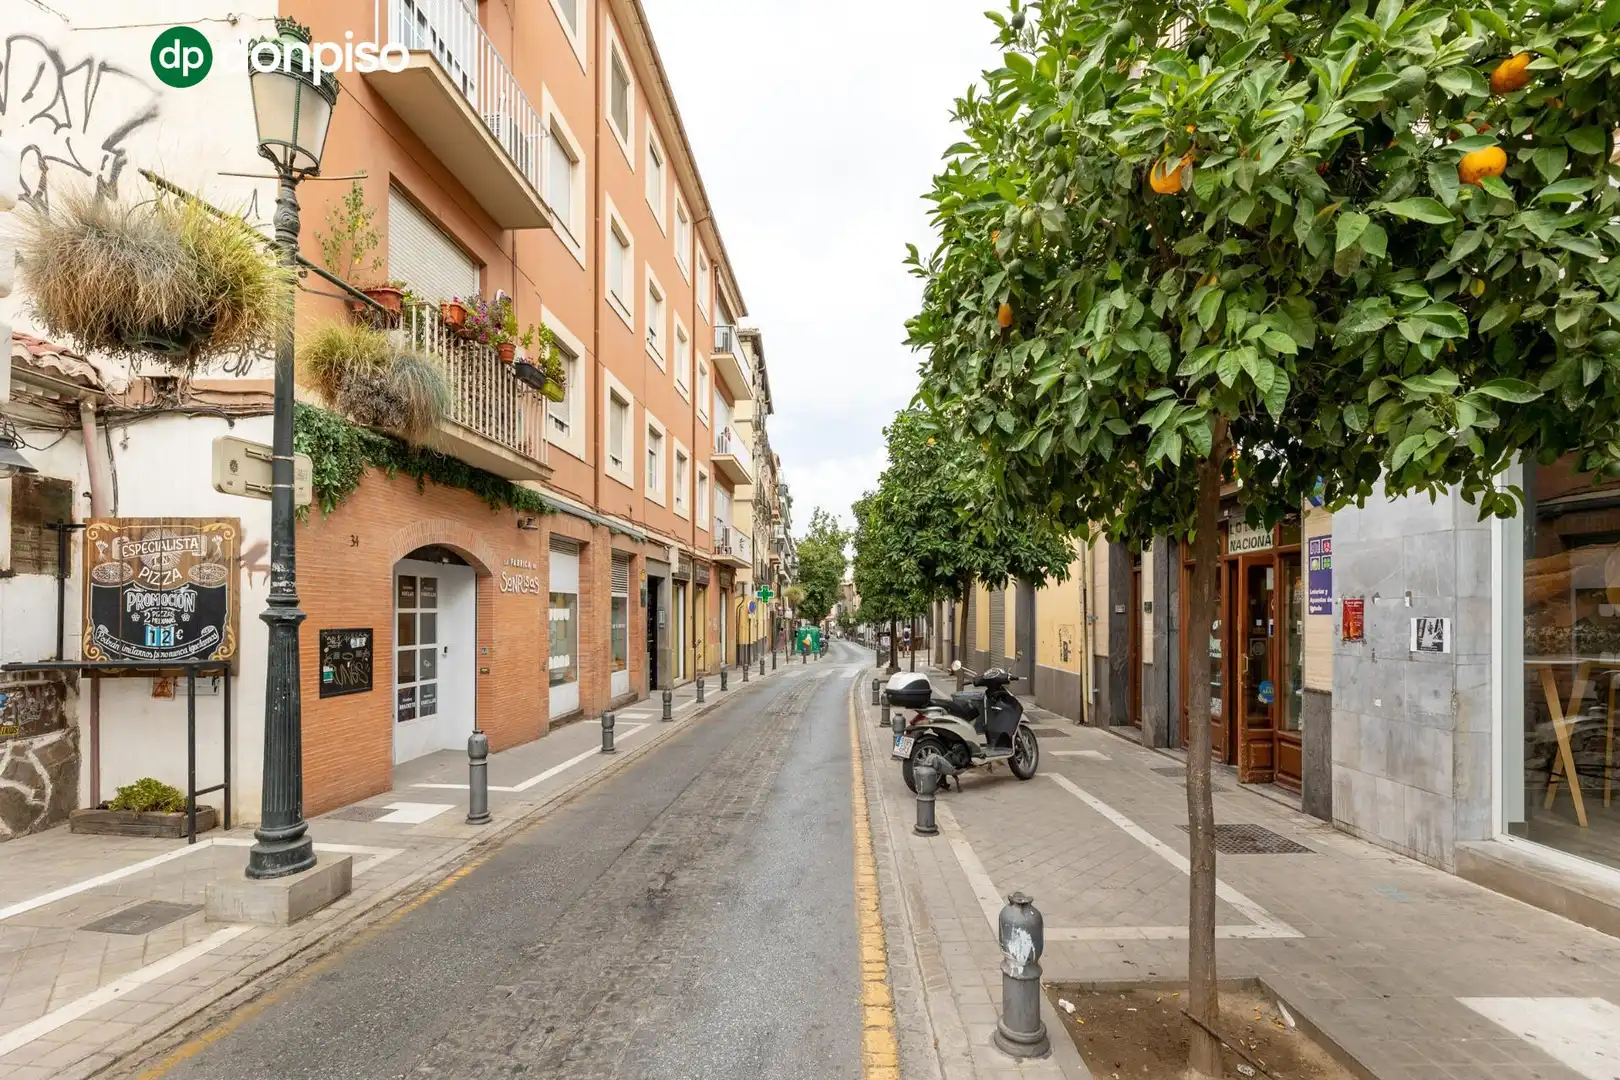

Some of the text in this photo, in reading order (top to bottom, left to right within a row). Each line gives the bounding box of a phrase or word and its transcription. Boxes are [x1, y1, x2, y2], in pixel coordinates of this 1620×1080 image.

[122, 537, 199, 558] ESPECIALISTA
[349, 534, 359, 547] 34
[1229, 534, 1272, 552] NACIONA
[138, 566, 182, 586] PIZZA
[144, 612, 151, 623] 2
